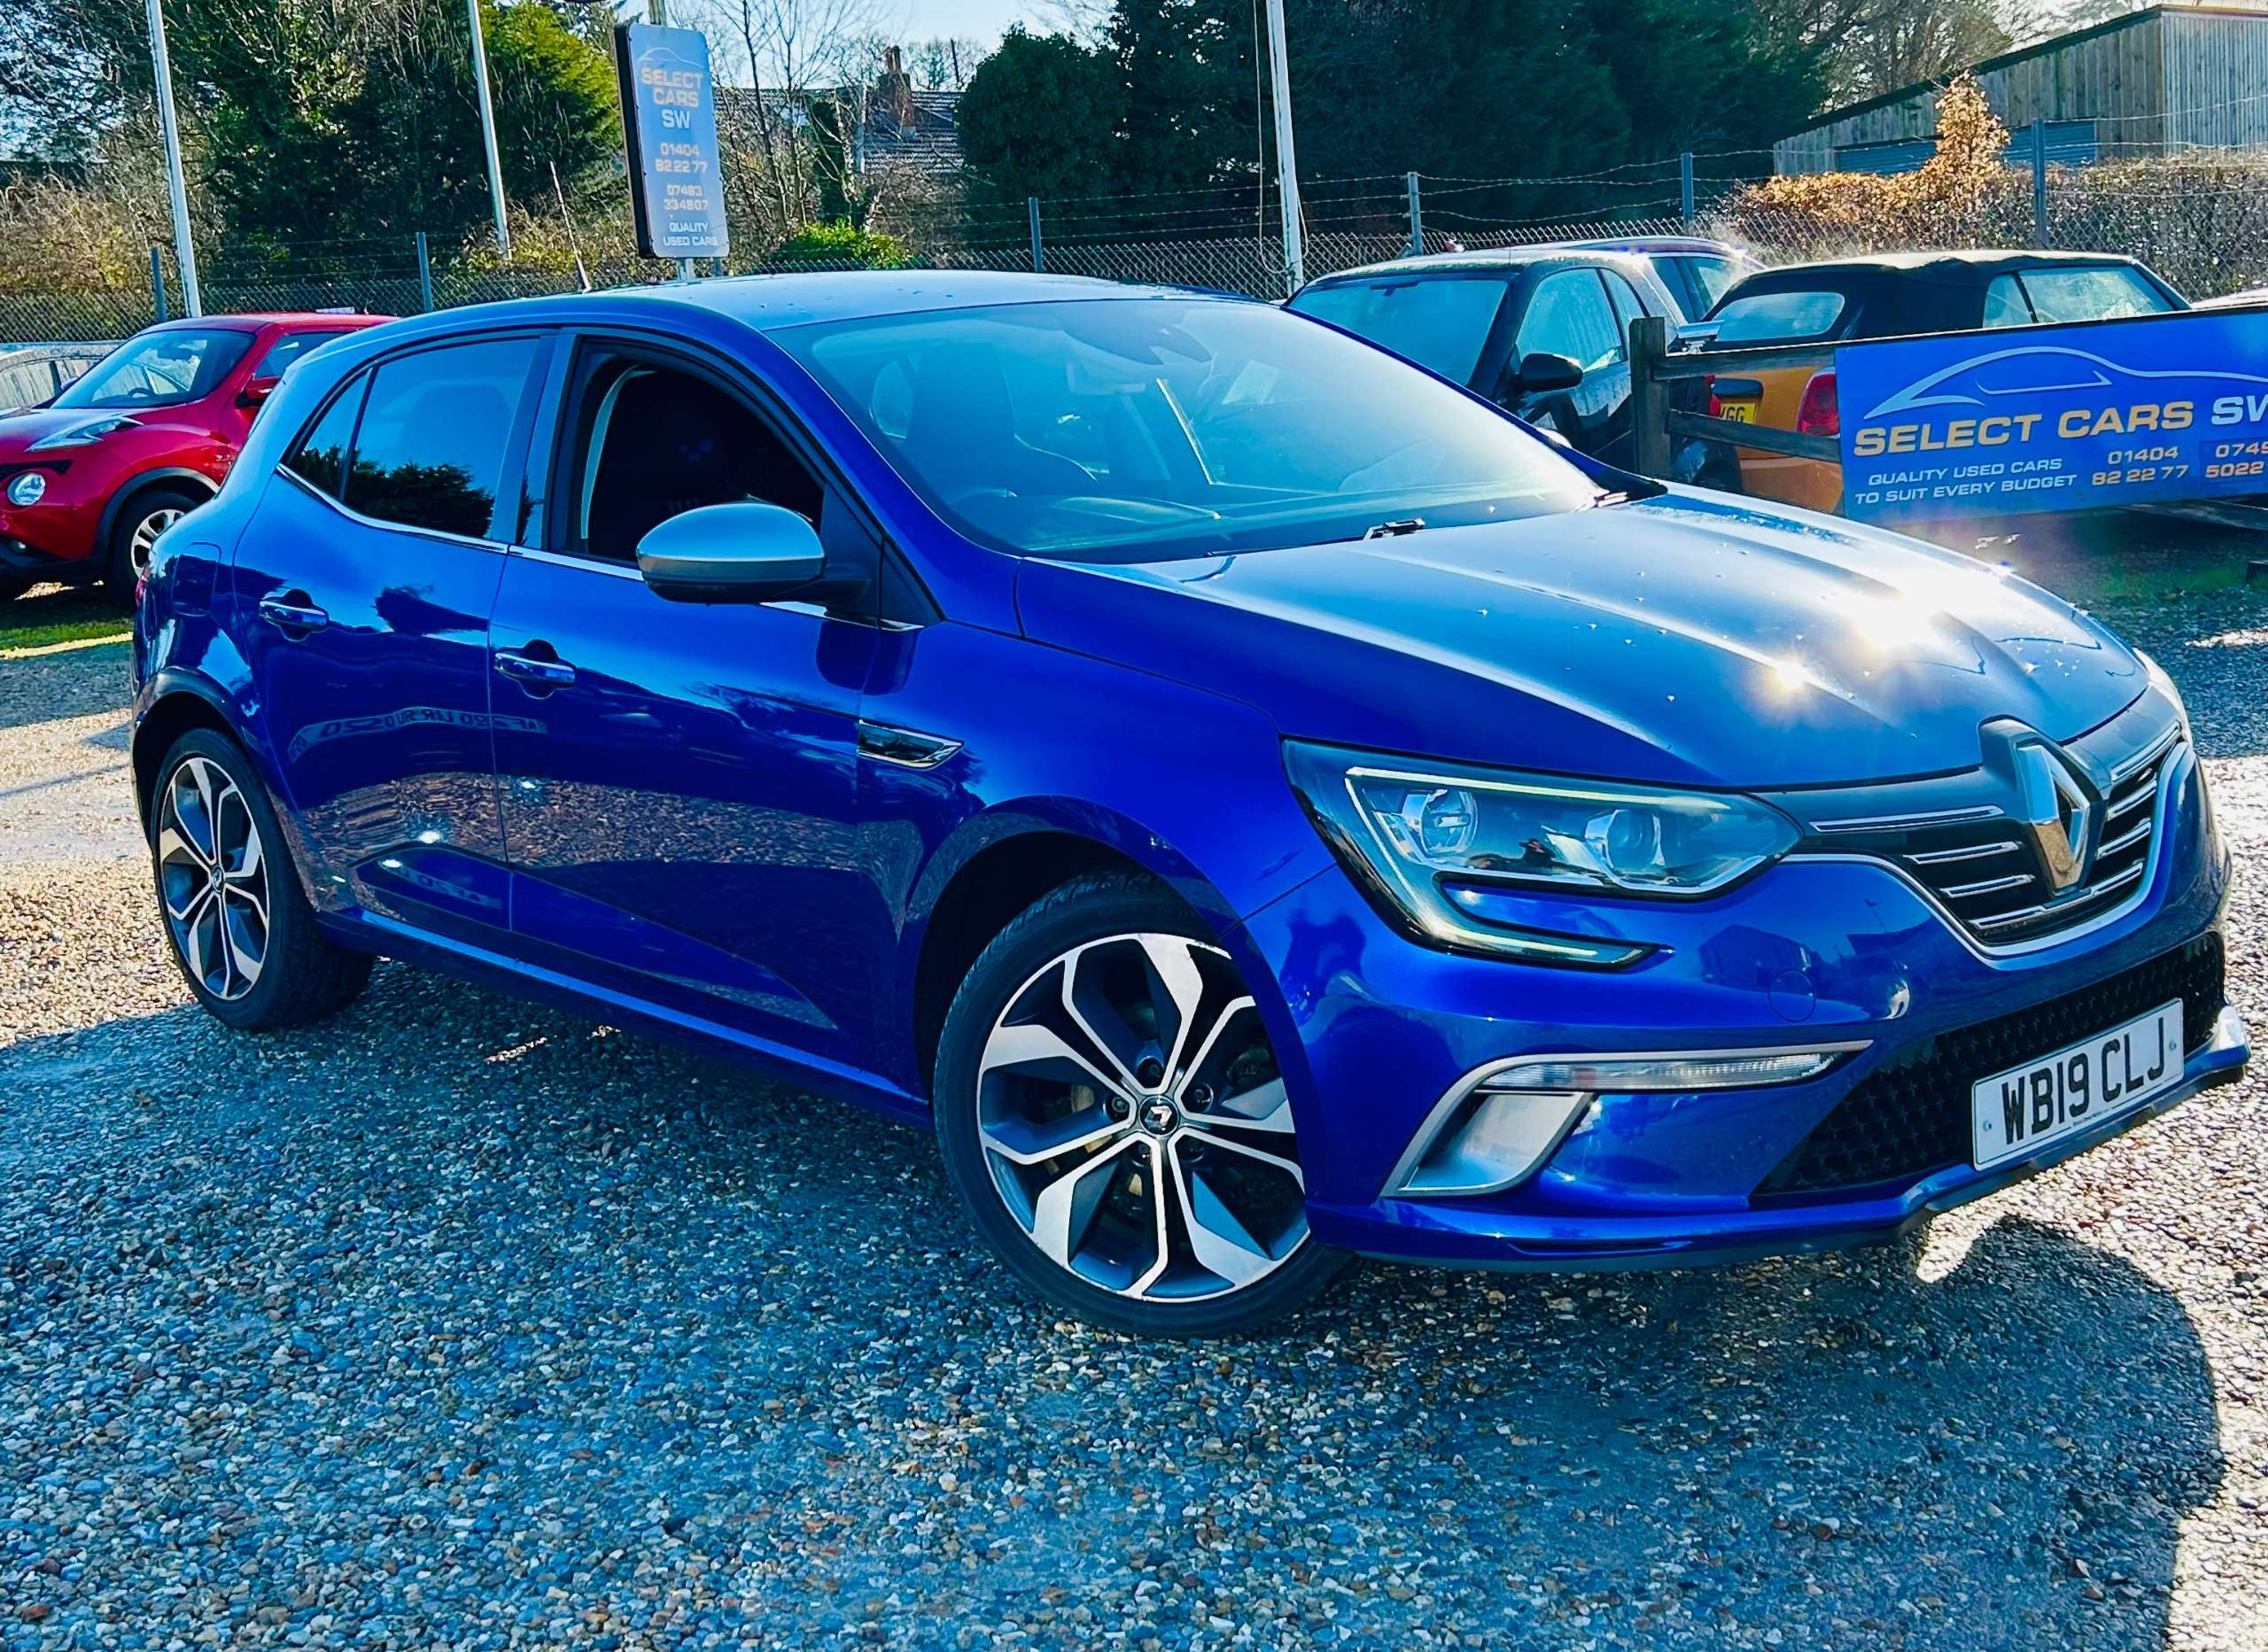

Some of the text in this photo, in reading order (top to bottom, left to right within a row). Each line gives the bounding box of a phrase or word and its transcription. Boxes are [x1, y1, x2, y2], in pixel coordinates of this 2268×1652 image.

[641, 67, 703, 89] SELECT
[653, 88, 699, 107] CARS
[661, 109, 690, 128] SW
[660, 142, 700, 157] 01404
[669, 221, 708, 233] QUALITY
[663, 236, 718, 246] USED CARS
[1852, 414, 2042, 456] SELECT
[2058, 400, 2194, 439] CARS
[2107, 446, 2179, 465] 01404
[1868, 458, 2062, 486] QUALITY USED CARS
[2092, 464, 2189, 486] 82 22 77
[1855, 475, 2078, 505] TO SUIT EVERY BUDGET
[2000, 1017, 2164, 1145] WB19 CLJ
